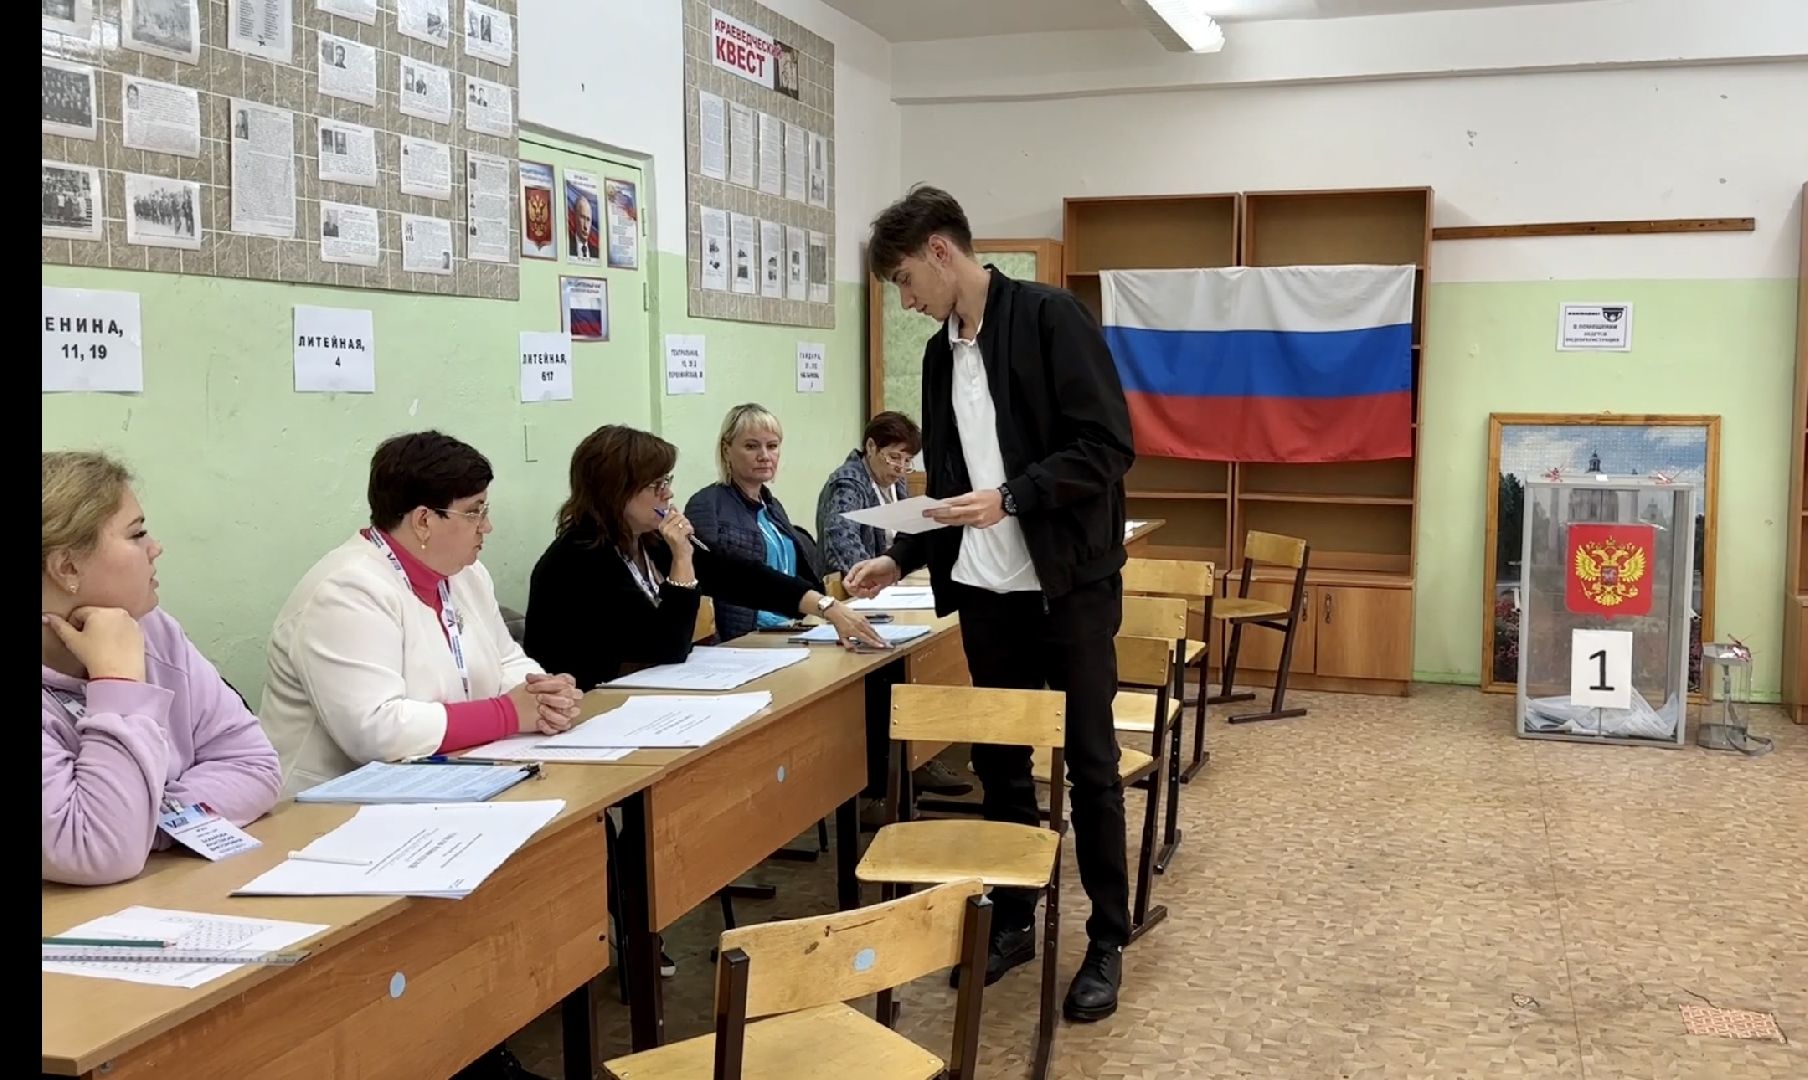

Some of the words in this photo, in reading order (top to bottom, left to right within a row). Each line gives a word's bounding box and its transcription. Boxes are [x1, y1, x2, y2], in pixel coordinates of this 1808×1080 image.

[715, 36, 765, 77] КВЕСТ
[61, 343, 84, 362] 11,
[89, 343, 107, 360] 19
[298, 335, 365, 352] ЛИТЕЙНАЯ,
[334, 355, 341, 367] 4
[1589, 649, 1615, 691] 1
